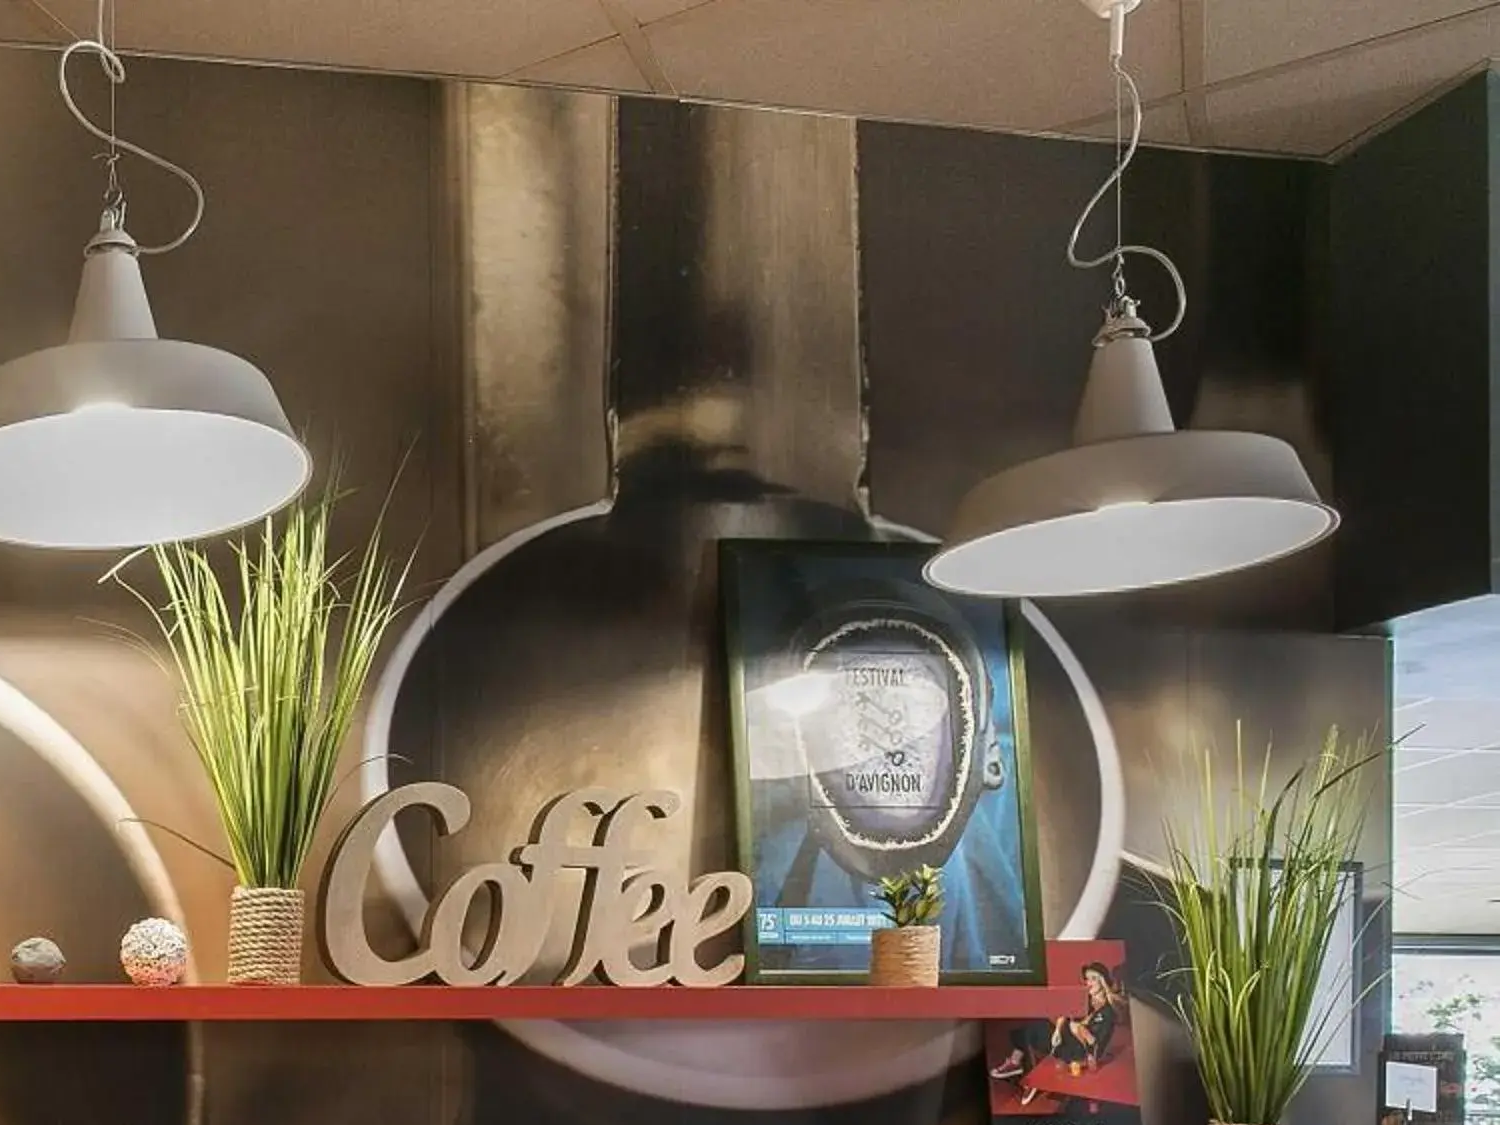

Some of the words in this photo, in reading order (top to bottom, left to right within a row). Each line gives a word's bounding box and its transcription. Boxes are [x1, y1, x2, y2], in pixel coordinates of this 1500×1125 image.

[844, 667, 908, 686] FESTIVAL
[844, 772, 921, 793] D'AVIGNON
[317, 781, 753, 987] Coffee
